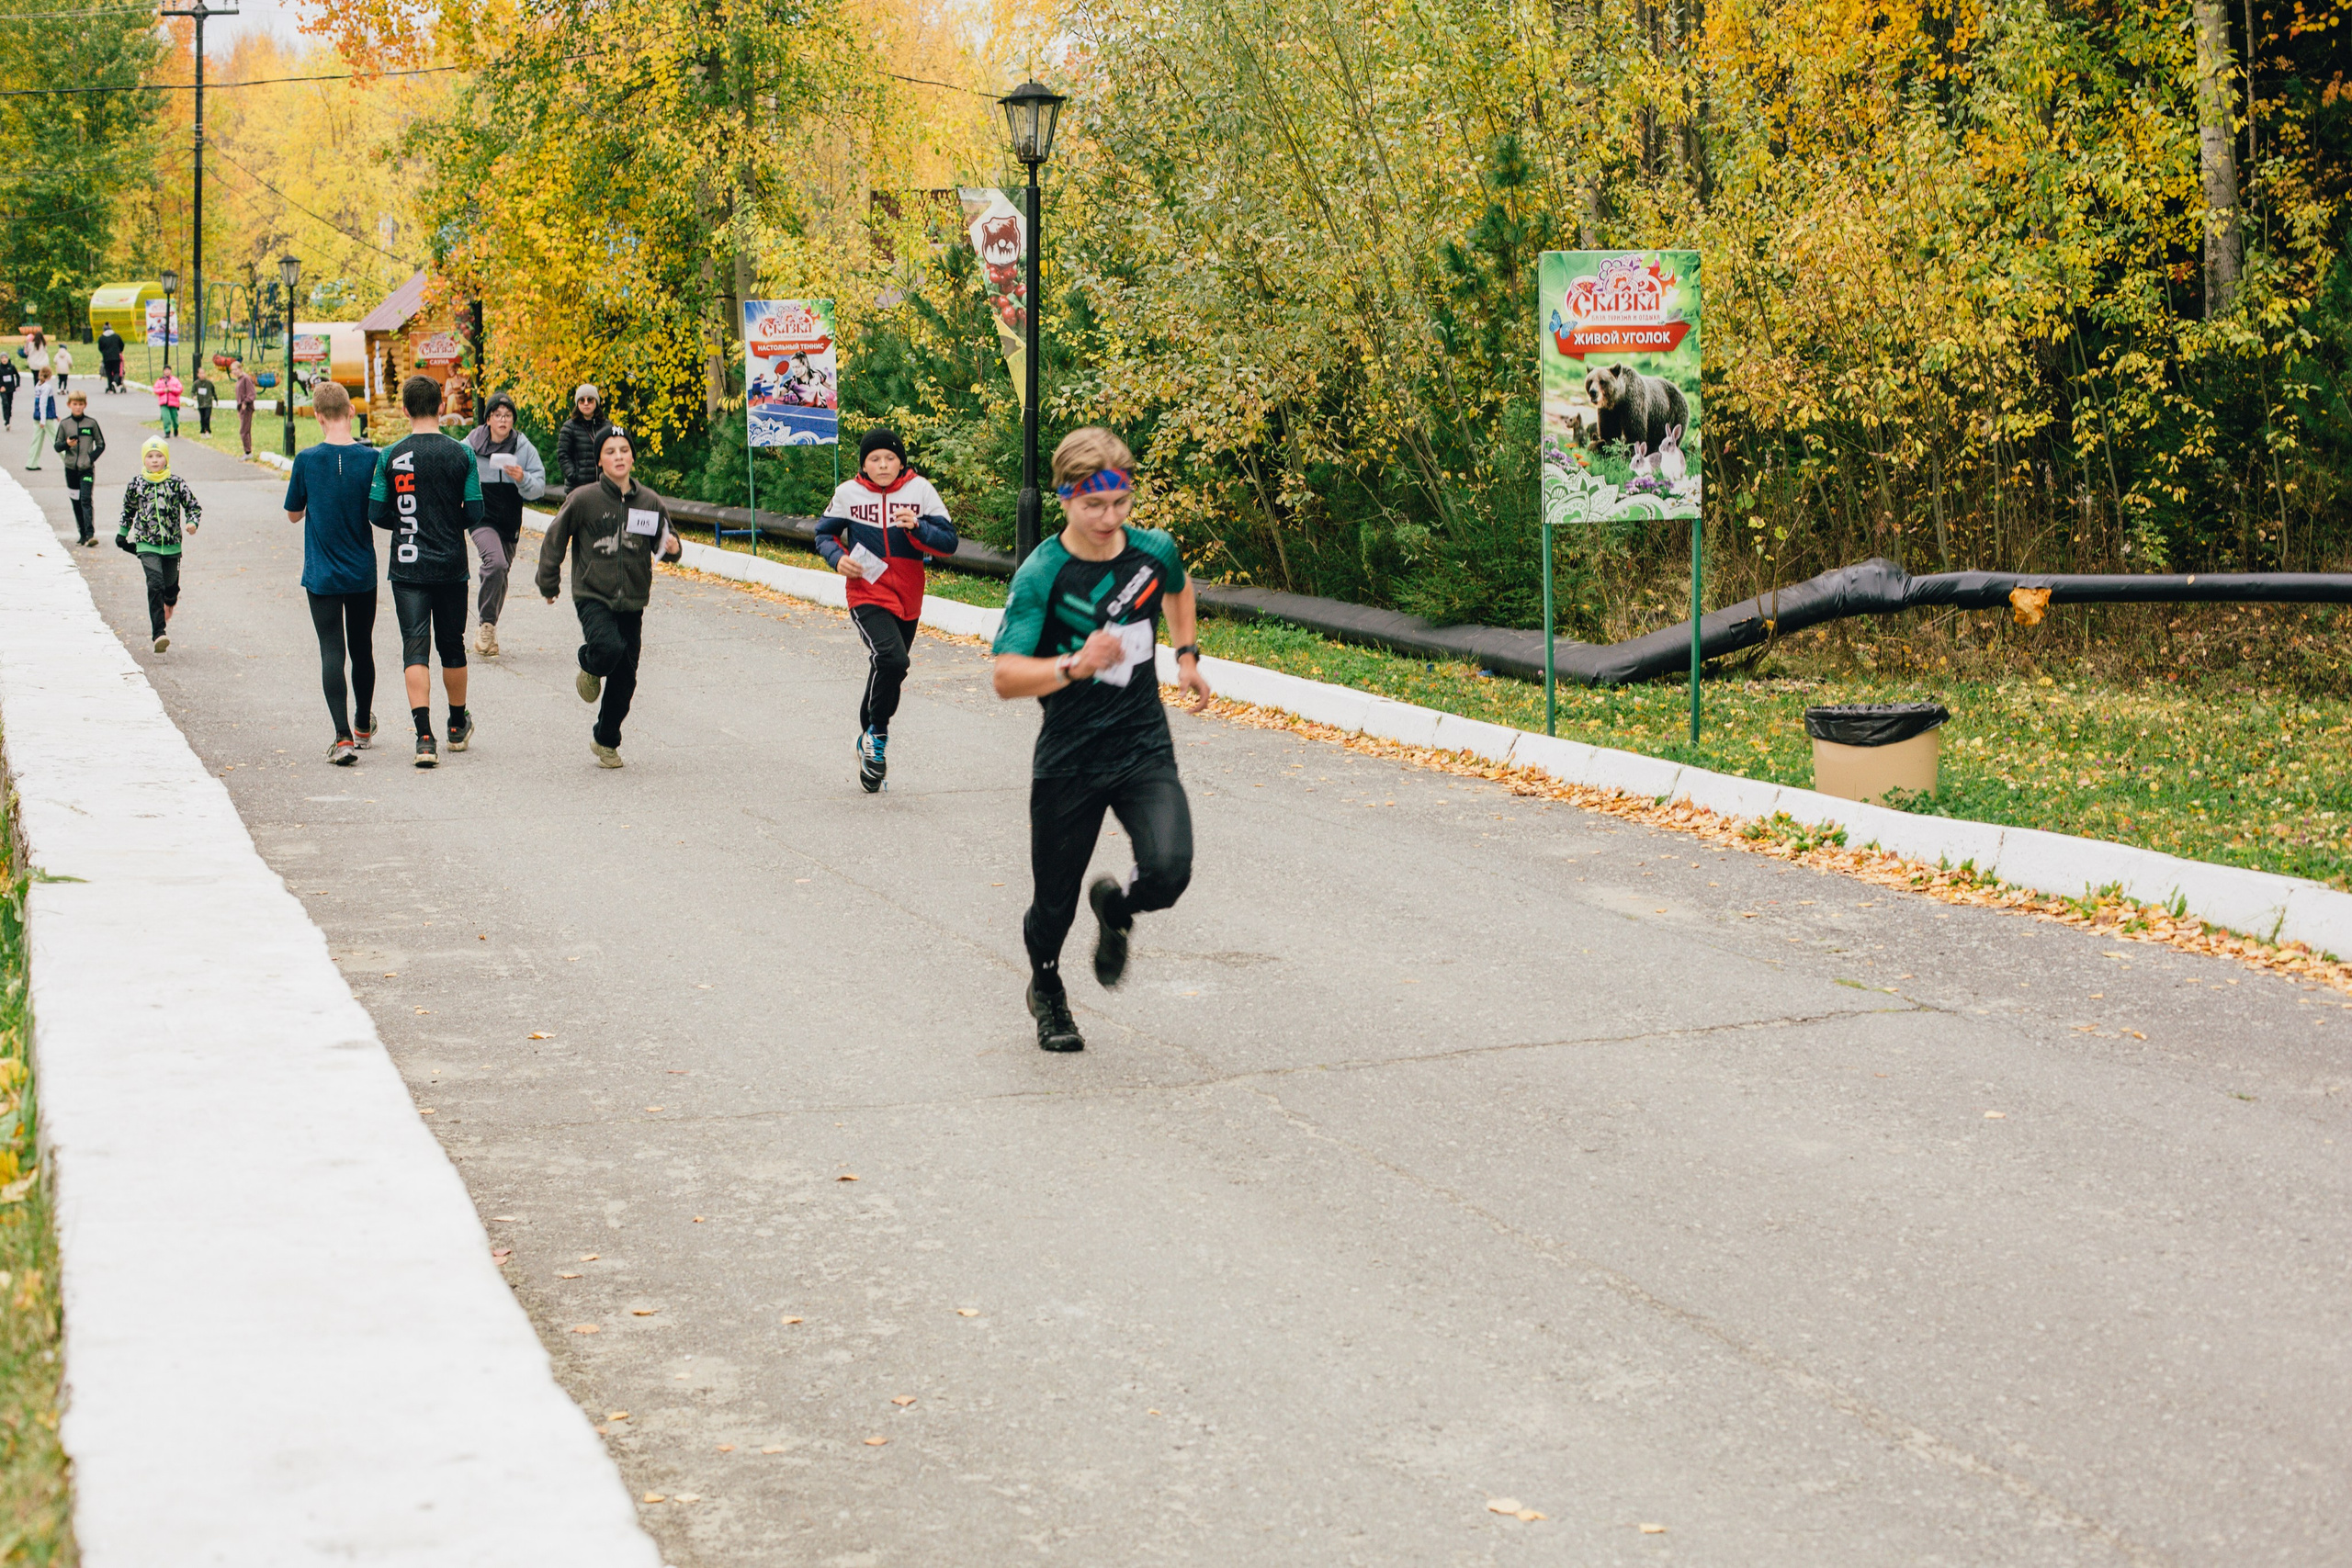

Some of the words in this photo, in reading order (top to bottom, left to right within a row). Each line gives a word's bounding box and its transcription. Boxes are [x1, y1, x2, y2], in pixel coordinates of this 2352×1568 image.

[1574, 331, 1620, 345] ЖИВОЙ
[1623, 331, 1670, 344] УГОЛОК
[757, 343, 799, 351] НАСТОЛЬНЫЙ
[392, 451, 418, 563] O-UGRA
